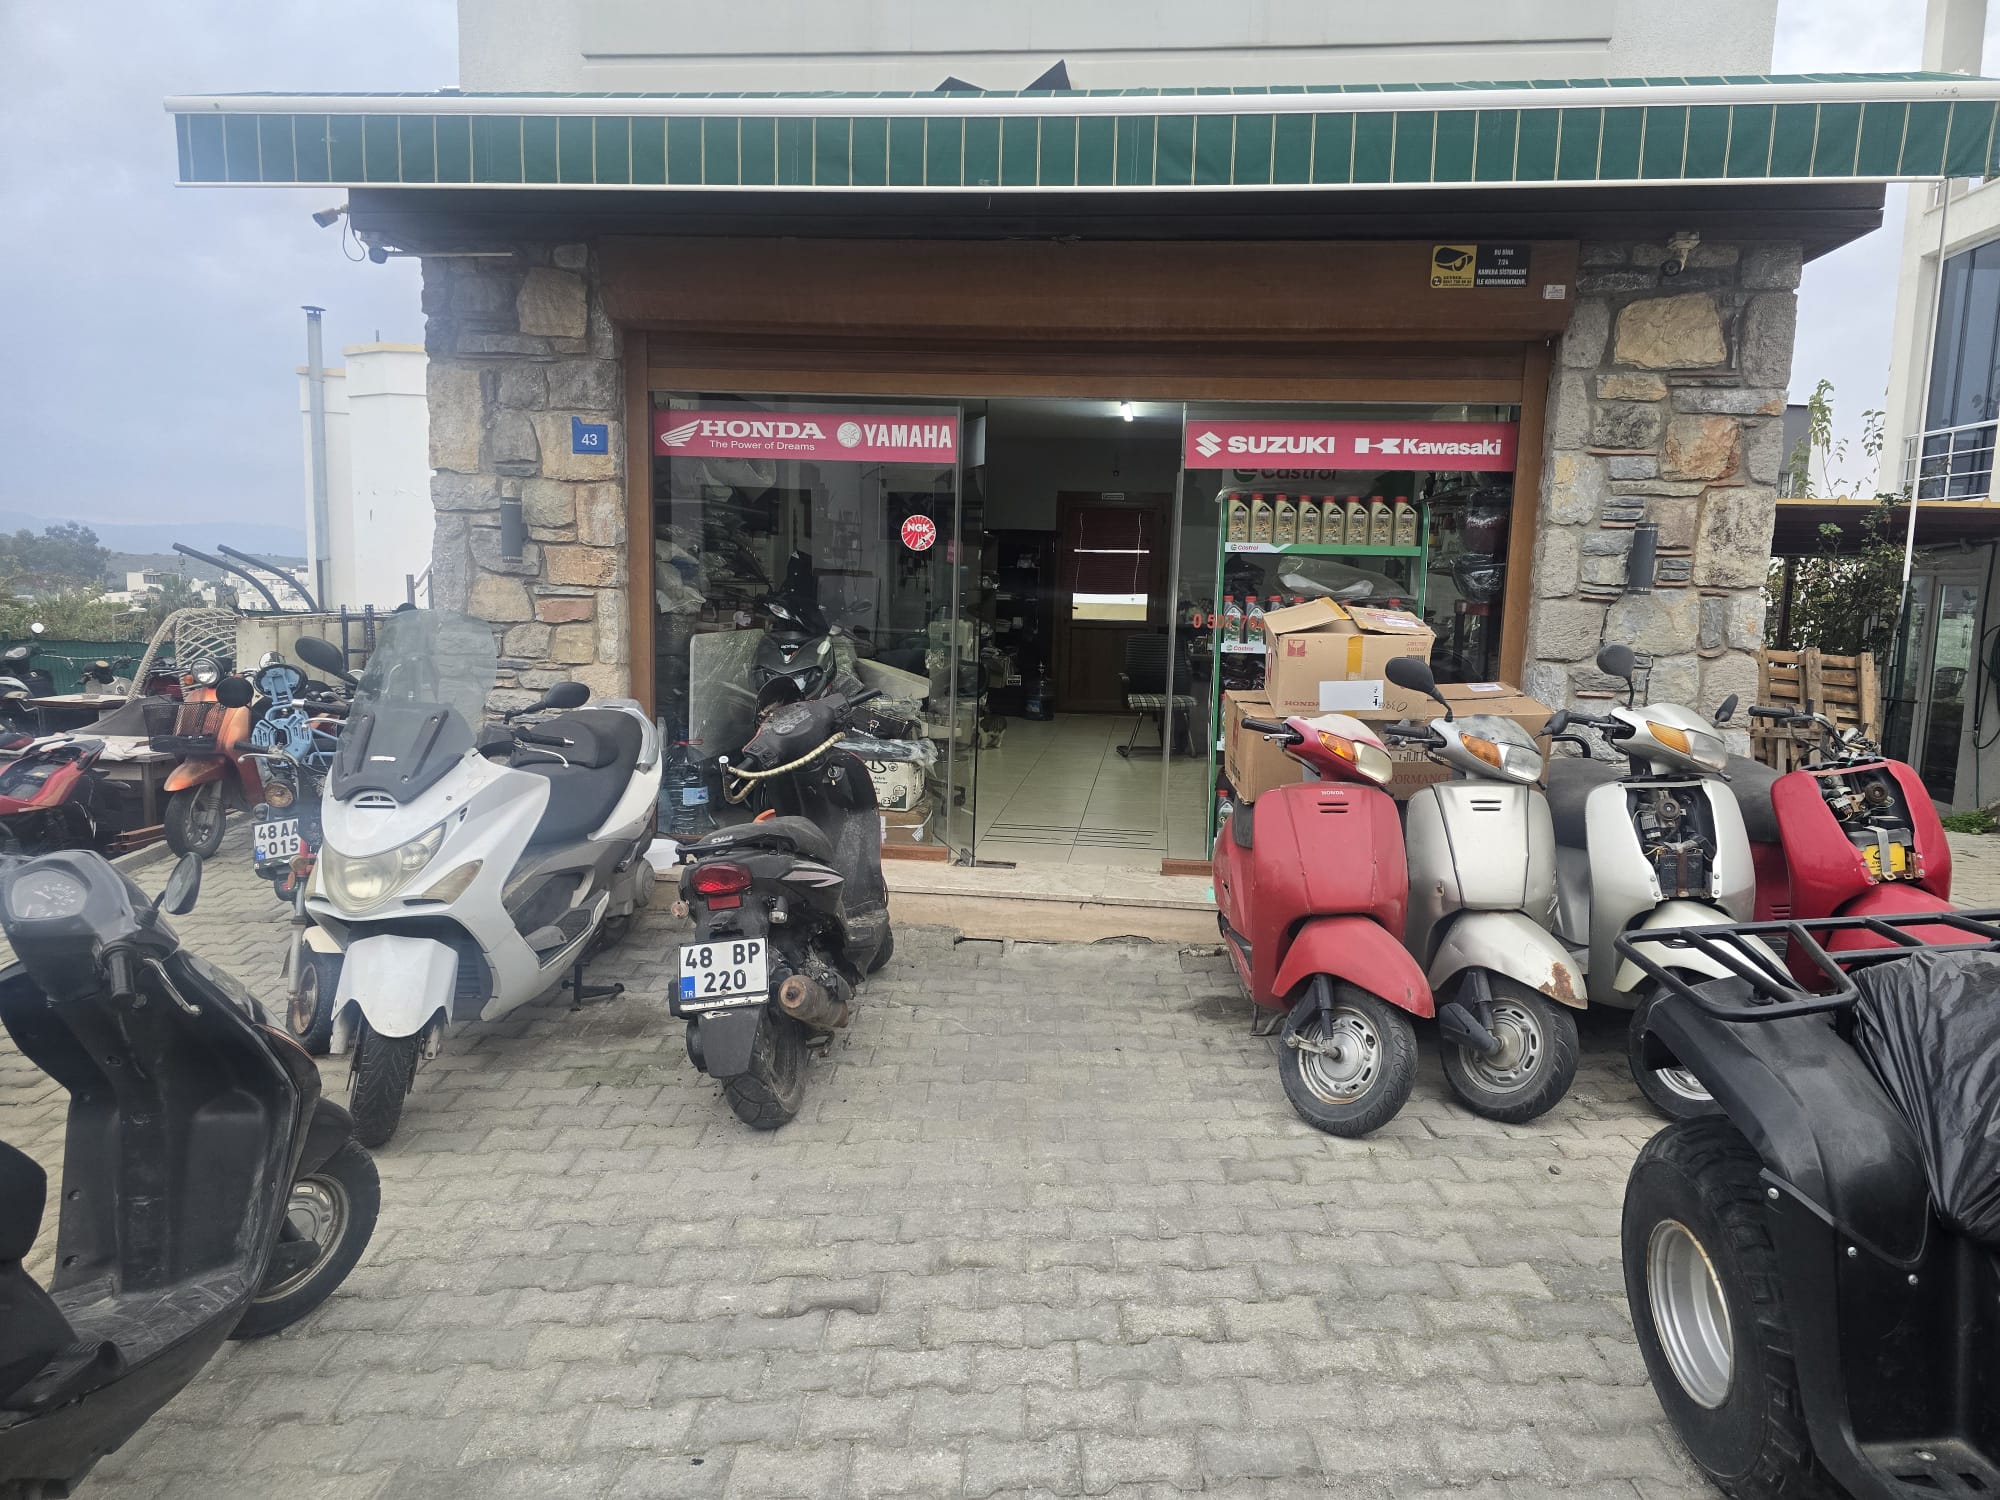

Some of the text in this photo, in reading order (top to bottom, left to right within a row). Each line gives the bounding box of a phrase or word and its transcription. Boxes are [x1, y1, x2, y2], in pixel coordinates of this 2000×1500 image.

[1499, 267, 1527, 275] SİSTEMLERİ
[700, 419, 826, 440] HONDA
[864, 423, 952, 448] YAMAHA
[581, 433, 598, 446] 43
[709, 440, 815, 451] The Power of Dreams
[1228, 435, 1336, 455] SUZUKI
[1403, 438, 1502, 456] Kawasaki
[907, 523, 930, 533] NGK
[1237, 543, 1259, 551] Castrol
[1192, 613, 1203, 628] 0
[258, 821, 298, 840] 48 AA
[268, 838, 299, 855] 015
[685, 942, 761, 969] 48 BP
[703, 969, 747, 993] 220
[685, 990, 694, 998] TR
